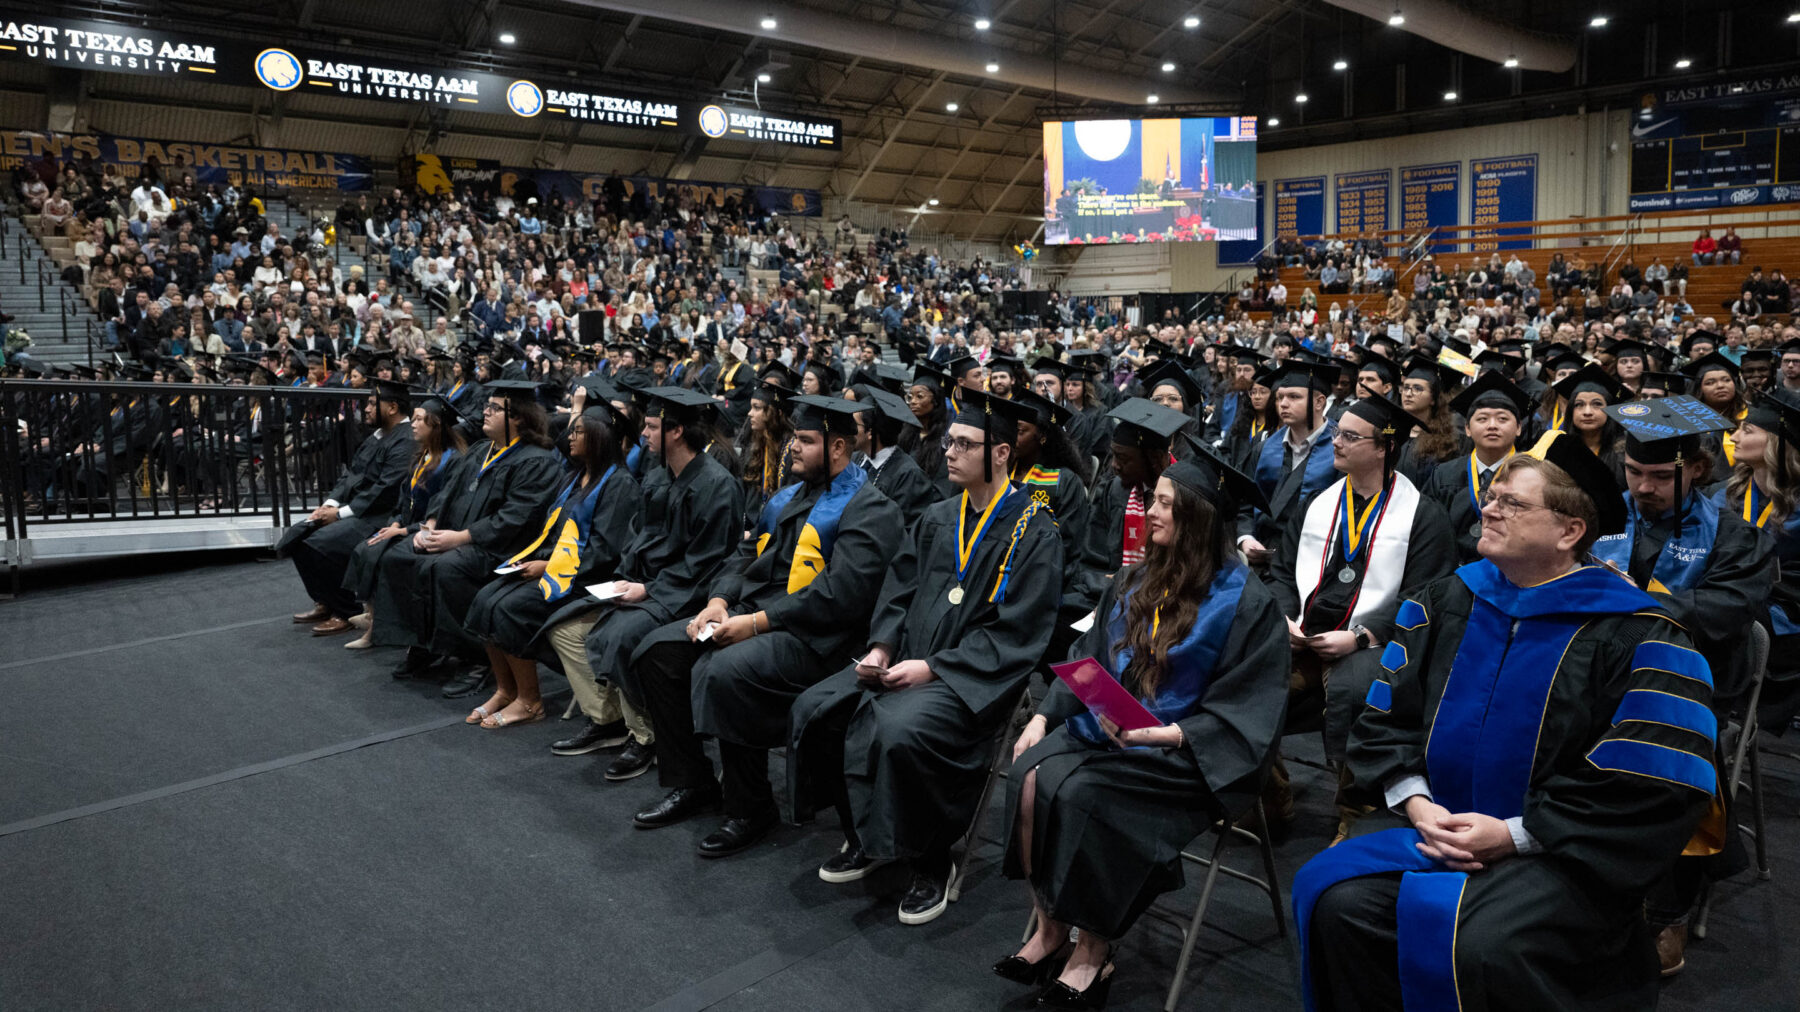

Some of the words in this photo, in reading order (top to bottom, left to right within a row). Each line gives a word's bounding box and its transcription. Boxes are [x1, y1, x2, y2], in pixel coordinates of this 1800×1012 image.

[0, 22, 58, 44] AST
[65, 29, 153, 56] TEXAS
[158, 41, 216, 64] A&M
[27, 45, 181, 72] UNIVERSITY
[307, 60, 363, 81] EAST
[368, 68, 432, 90] TEXAS
[436, 77, 478, 95] A&M
[339, 81, 452, 104] UNIVERSITY
[1665, 86, 1709, 103] EAST
[546, 90, 588, 108] EAST
[592, 95, 642, 114] TEXAS
[644, 102, 678, 118] A&M
[570, 108, 658, 126] UNIVERSITY
[730, 112, 762, 130] EAST
[766, 118, 804, 134] TEXAS
[806, 124, 834, 138] A&M
[748, 130, 818, 144] UNIVERSITY
[0, 130, 101, 159] EN'S
[115, 138, 345, 175] BASKETBALL
[1486, 160, 1535, 170] FOOTBALL
[1414, 168, 1457, 177] FOOTBALL
[1347, 175, 1388, 184] FOOTBALL
[1476, 179, 1500, 188] 1990
[1430, 182, 1454, 192] 2016
[1476, 188, 1498, 197] 1991
[1476, 197, 1500, 206] 1995
[1632, 198, 1671, 208] Domino's
[1476, 206, 1498, 215] 2015
[1404, 220, 1428, 229] 2007
[1475, 215, 1498, 224] 2016
[1669, 542, 1688, 552] EAST
